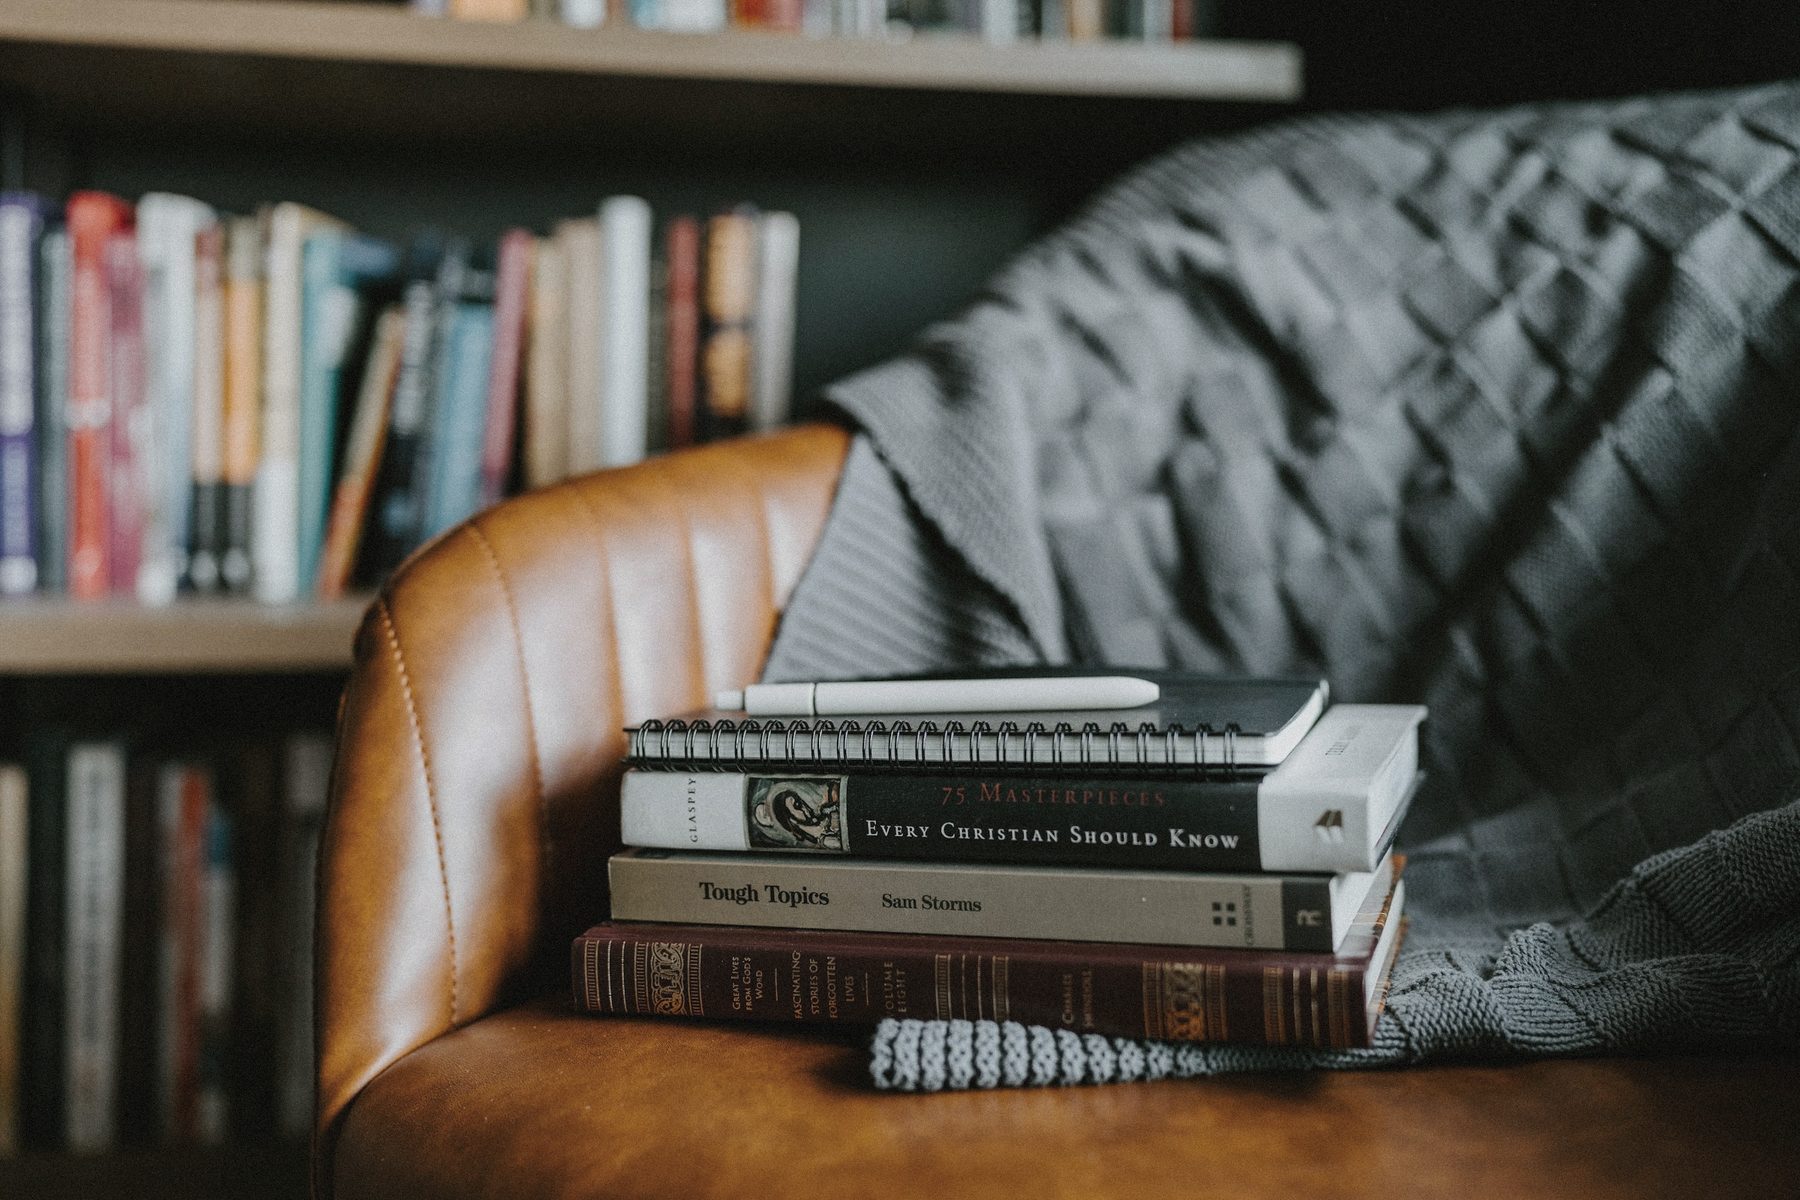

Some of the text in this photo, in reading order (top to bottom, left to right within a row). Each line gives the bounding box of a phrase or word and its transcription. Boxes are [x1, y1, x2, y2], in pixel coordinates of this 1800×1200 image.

[688, 778, 698, 843] GLASPEY
[941, 782, 1166, 807] 75 MASTERPIECES
[865, 819, 1240, 850] EVERY CHRISTIAN SHOULD KNOW
[699, 881, 829, 909] Tough Topics
[882, 894, 982, 911] Sam Storms
[731, 956, 741, 1010] GREAT LIVES
[742, 956, 753, 1010] FROM GOD'S
[755, 970, 763, 999] WORD
[791, 950, 802, 1019] FASCINATING
[809, 958, 820, 1015] STORIES OF
[827, 956, 838, 1018] FORGOTTEN
[845, 975, 855, 1002] LIVES
[896, 969, 907, 1013] EIGHT
